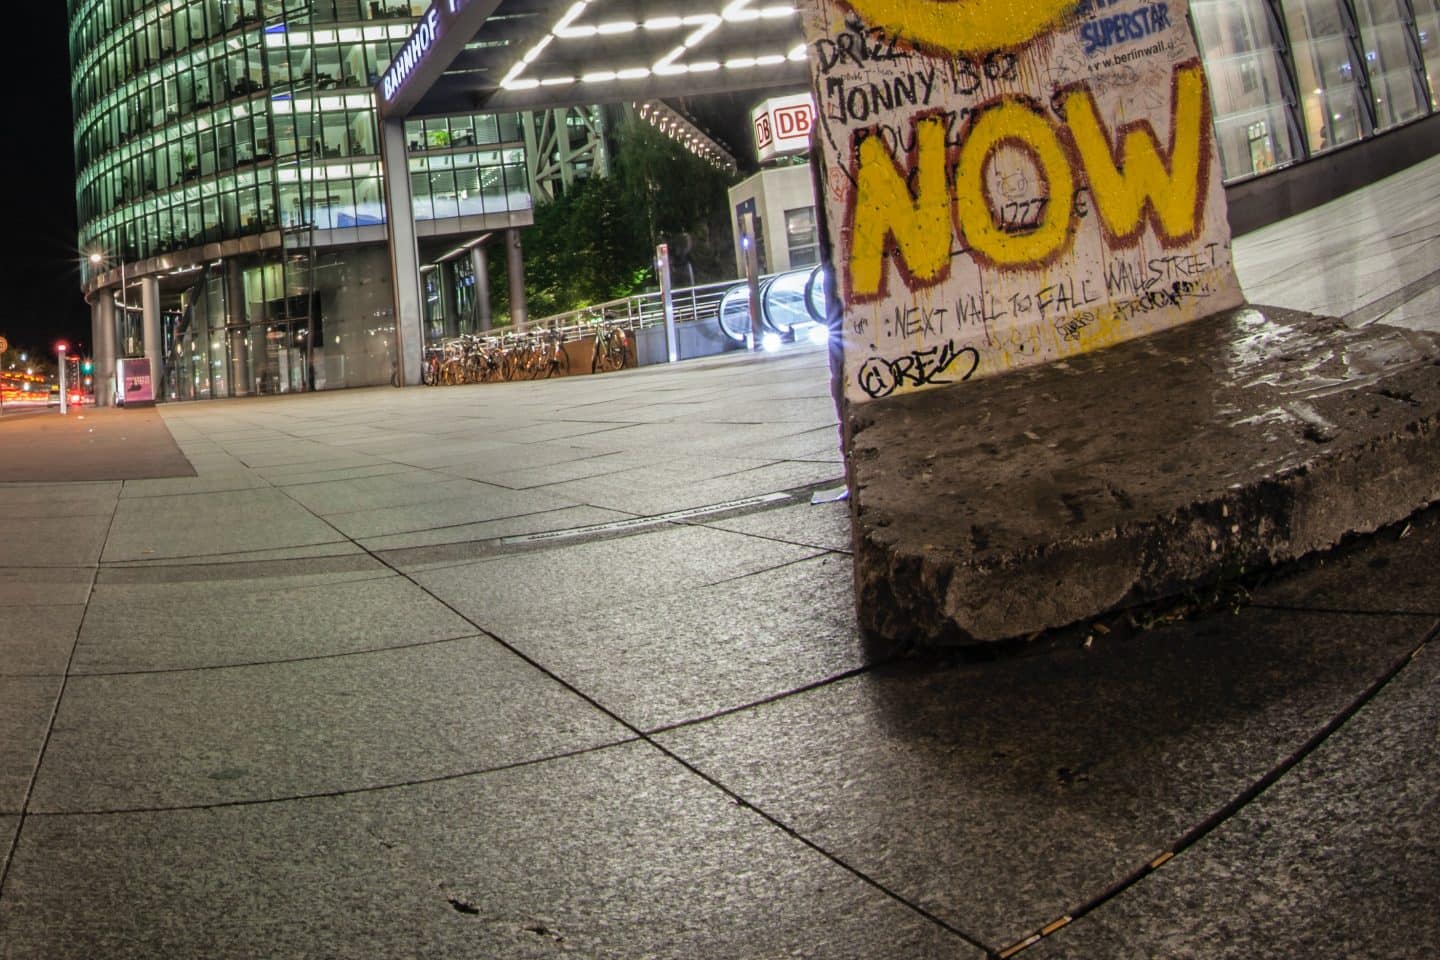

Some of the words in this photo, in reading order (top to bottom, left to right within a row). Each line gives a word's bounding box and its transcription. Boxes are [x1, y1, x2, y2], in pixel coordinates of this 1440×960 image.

[383, 9, 440, 101] BAHNHOF
[1081, 2, 1171, 55] SUPERSTAR
[779, 110, 809, 134] DB
[843, 57, 1212, 304] NOW
